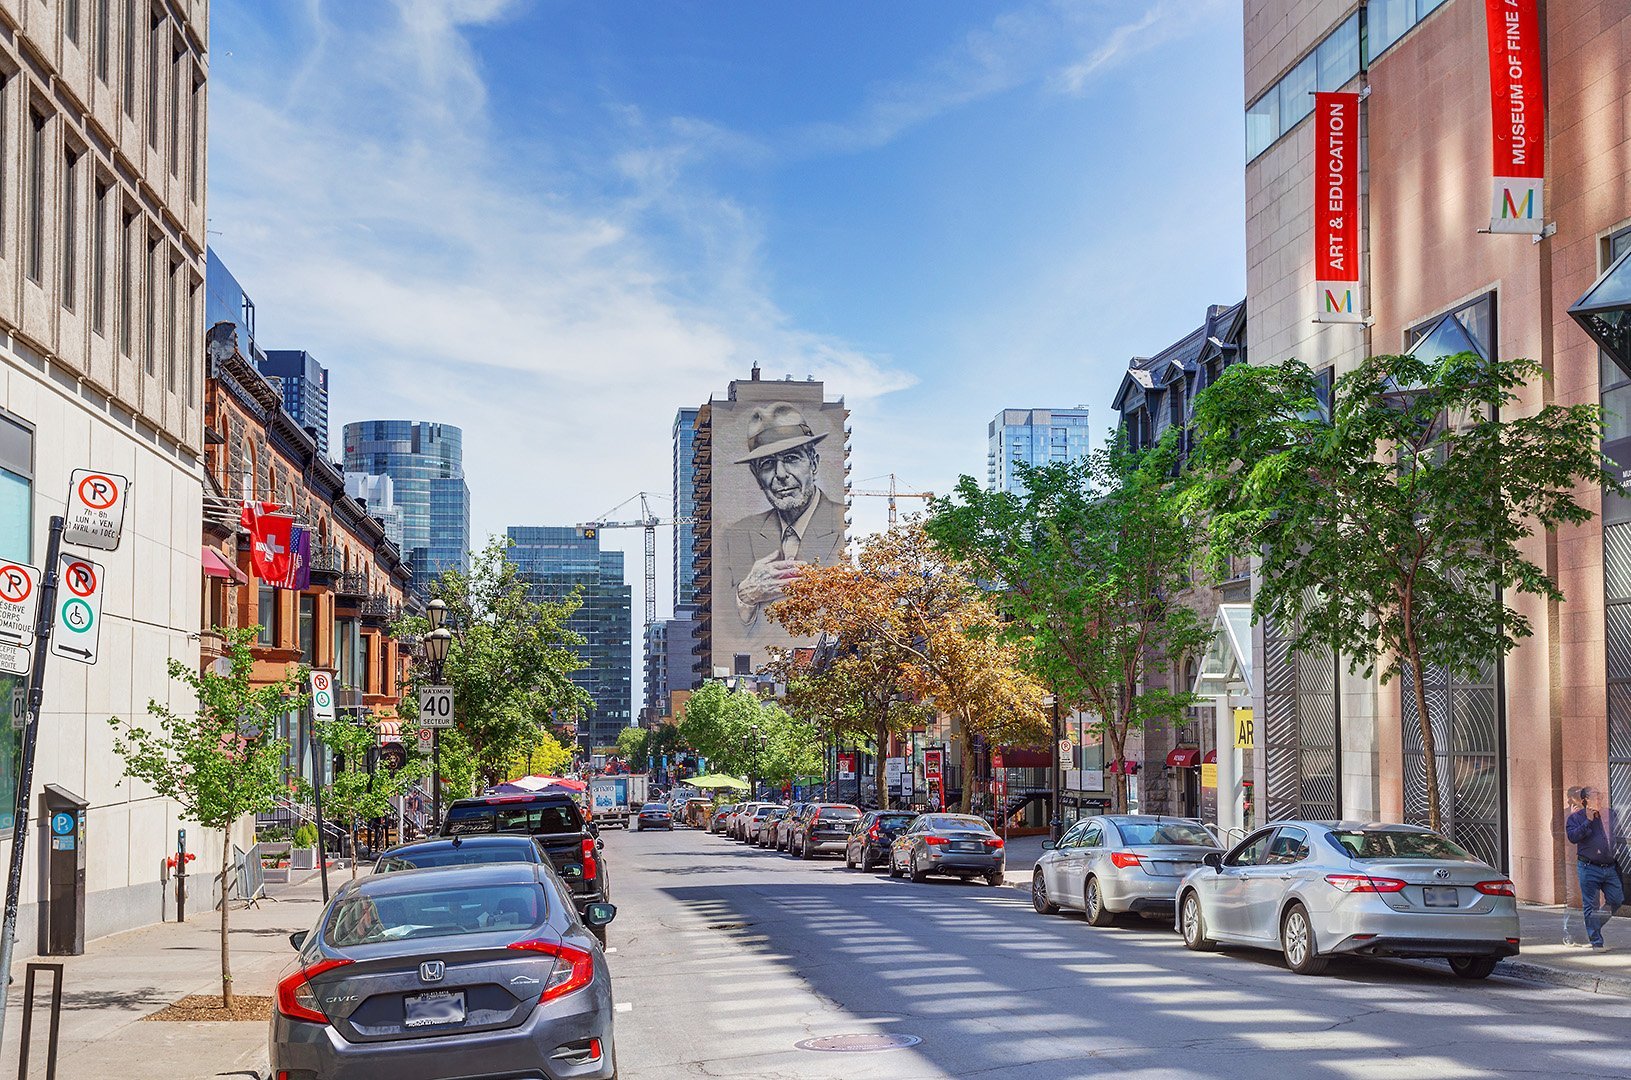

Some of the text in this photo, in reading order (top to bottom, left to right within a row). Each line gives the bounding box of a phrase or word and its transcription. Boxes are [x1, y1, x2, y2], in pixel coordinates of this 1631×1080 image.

[1505, 11, 1521, 50] FINE
[1508, 54, 1523, 79] OF
[1509, 84, 1526, 165] MUSEUM
[1329, 103, 1344, 271] ART & EDUCATION
[73, 523, 89, 533] AVRIL
[75, 515, 89, 524] LUN
[100, 519, 113, 529] VEN
[423, 696, 450, 717] 40
[326, 994, 359, 1003] CIVIC
